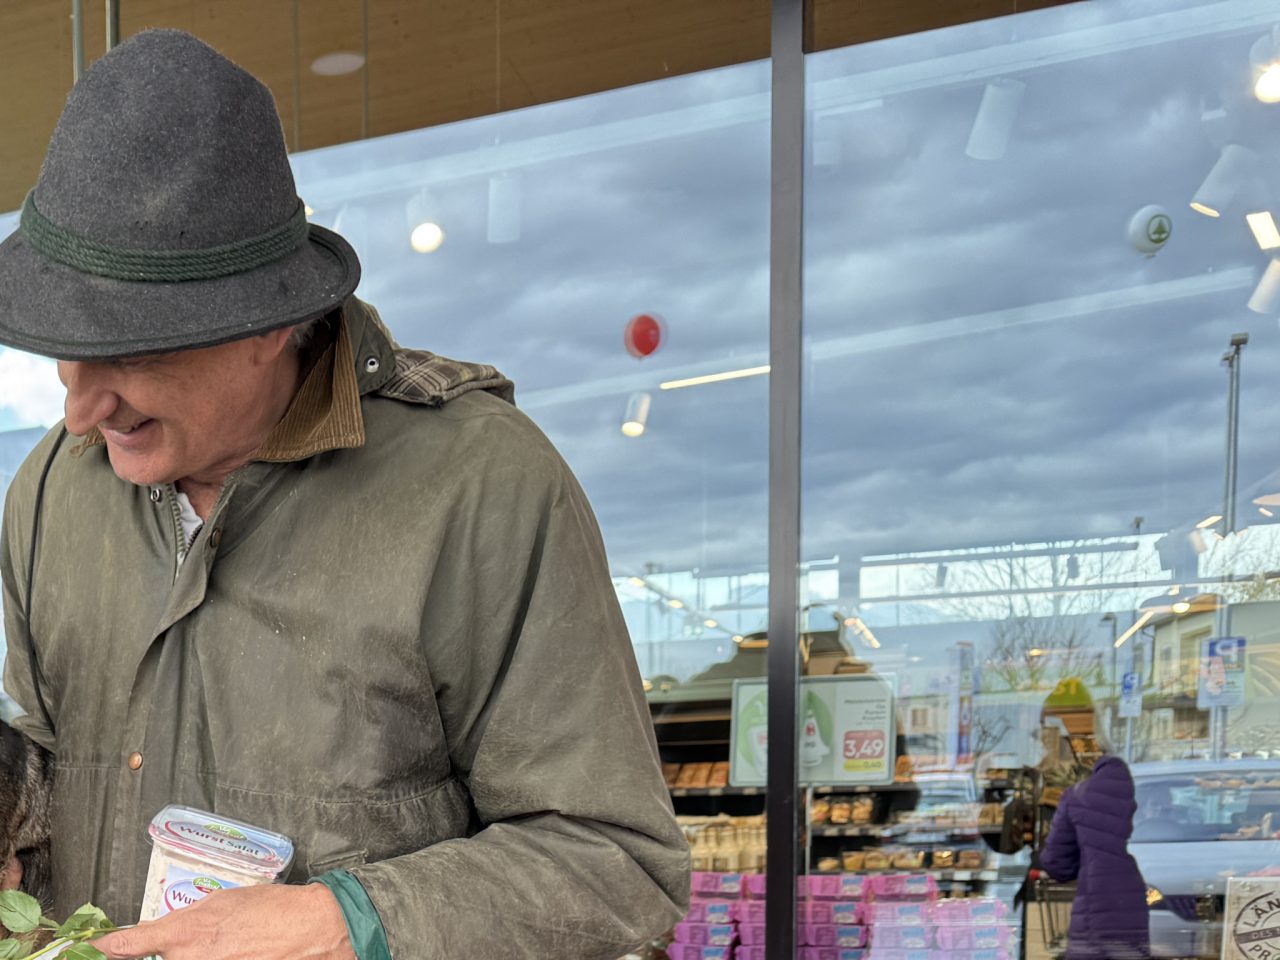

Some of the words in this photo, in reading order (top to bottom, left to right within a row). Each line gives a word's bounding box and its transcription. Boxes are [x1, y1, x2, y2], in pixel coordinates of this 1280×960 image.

[845, 738, 883, 758] 3,49
[180, 825, 225, 843] Wurst
[226, 841, 260, 856] Salat
